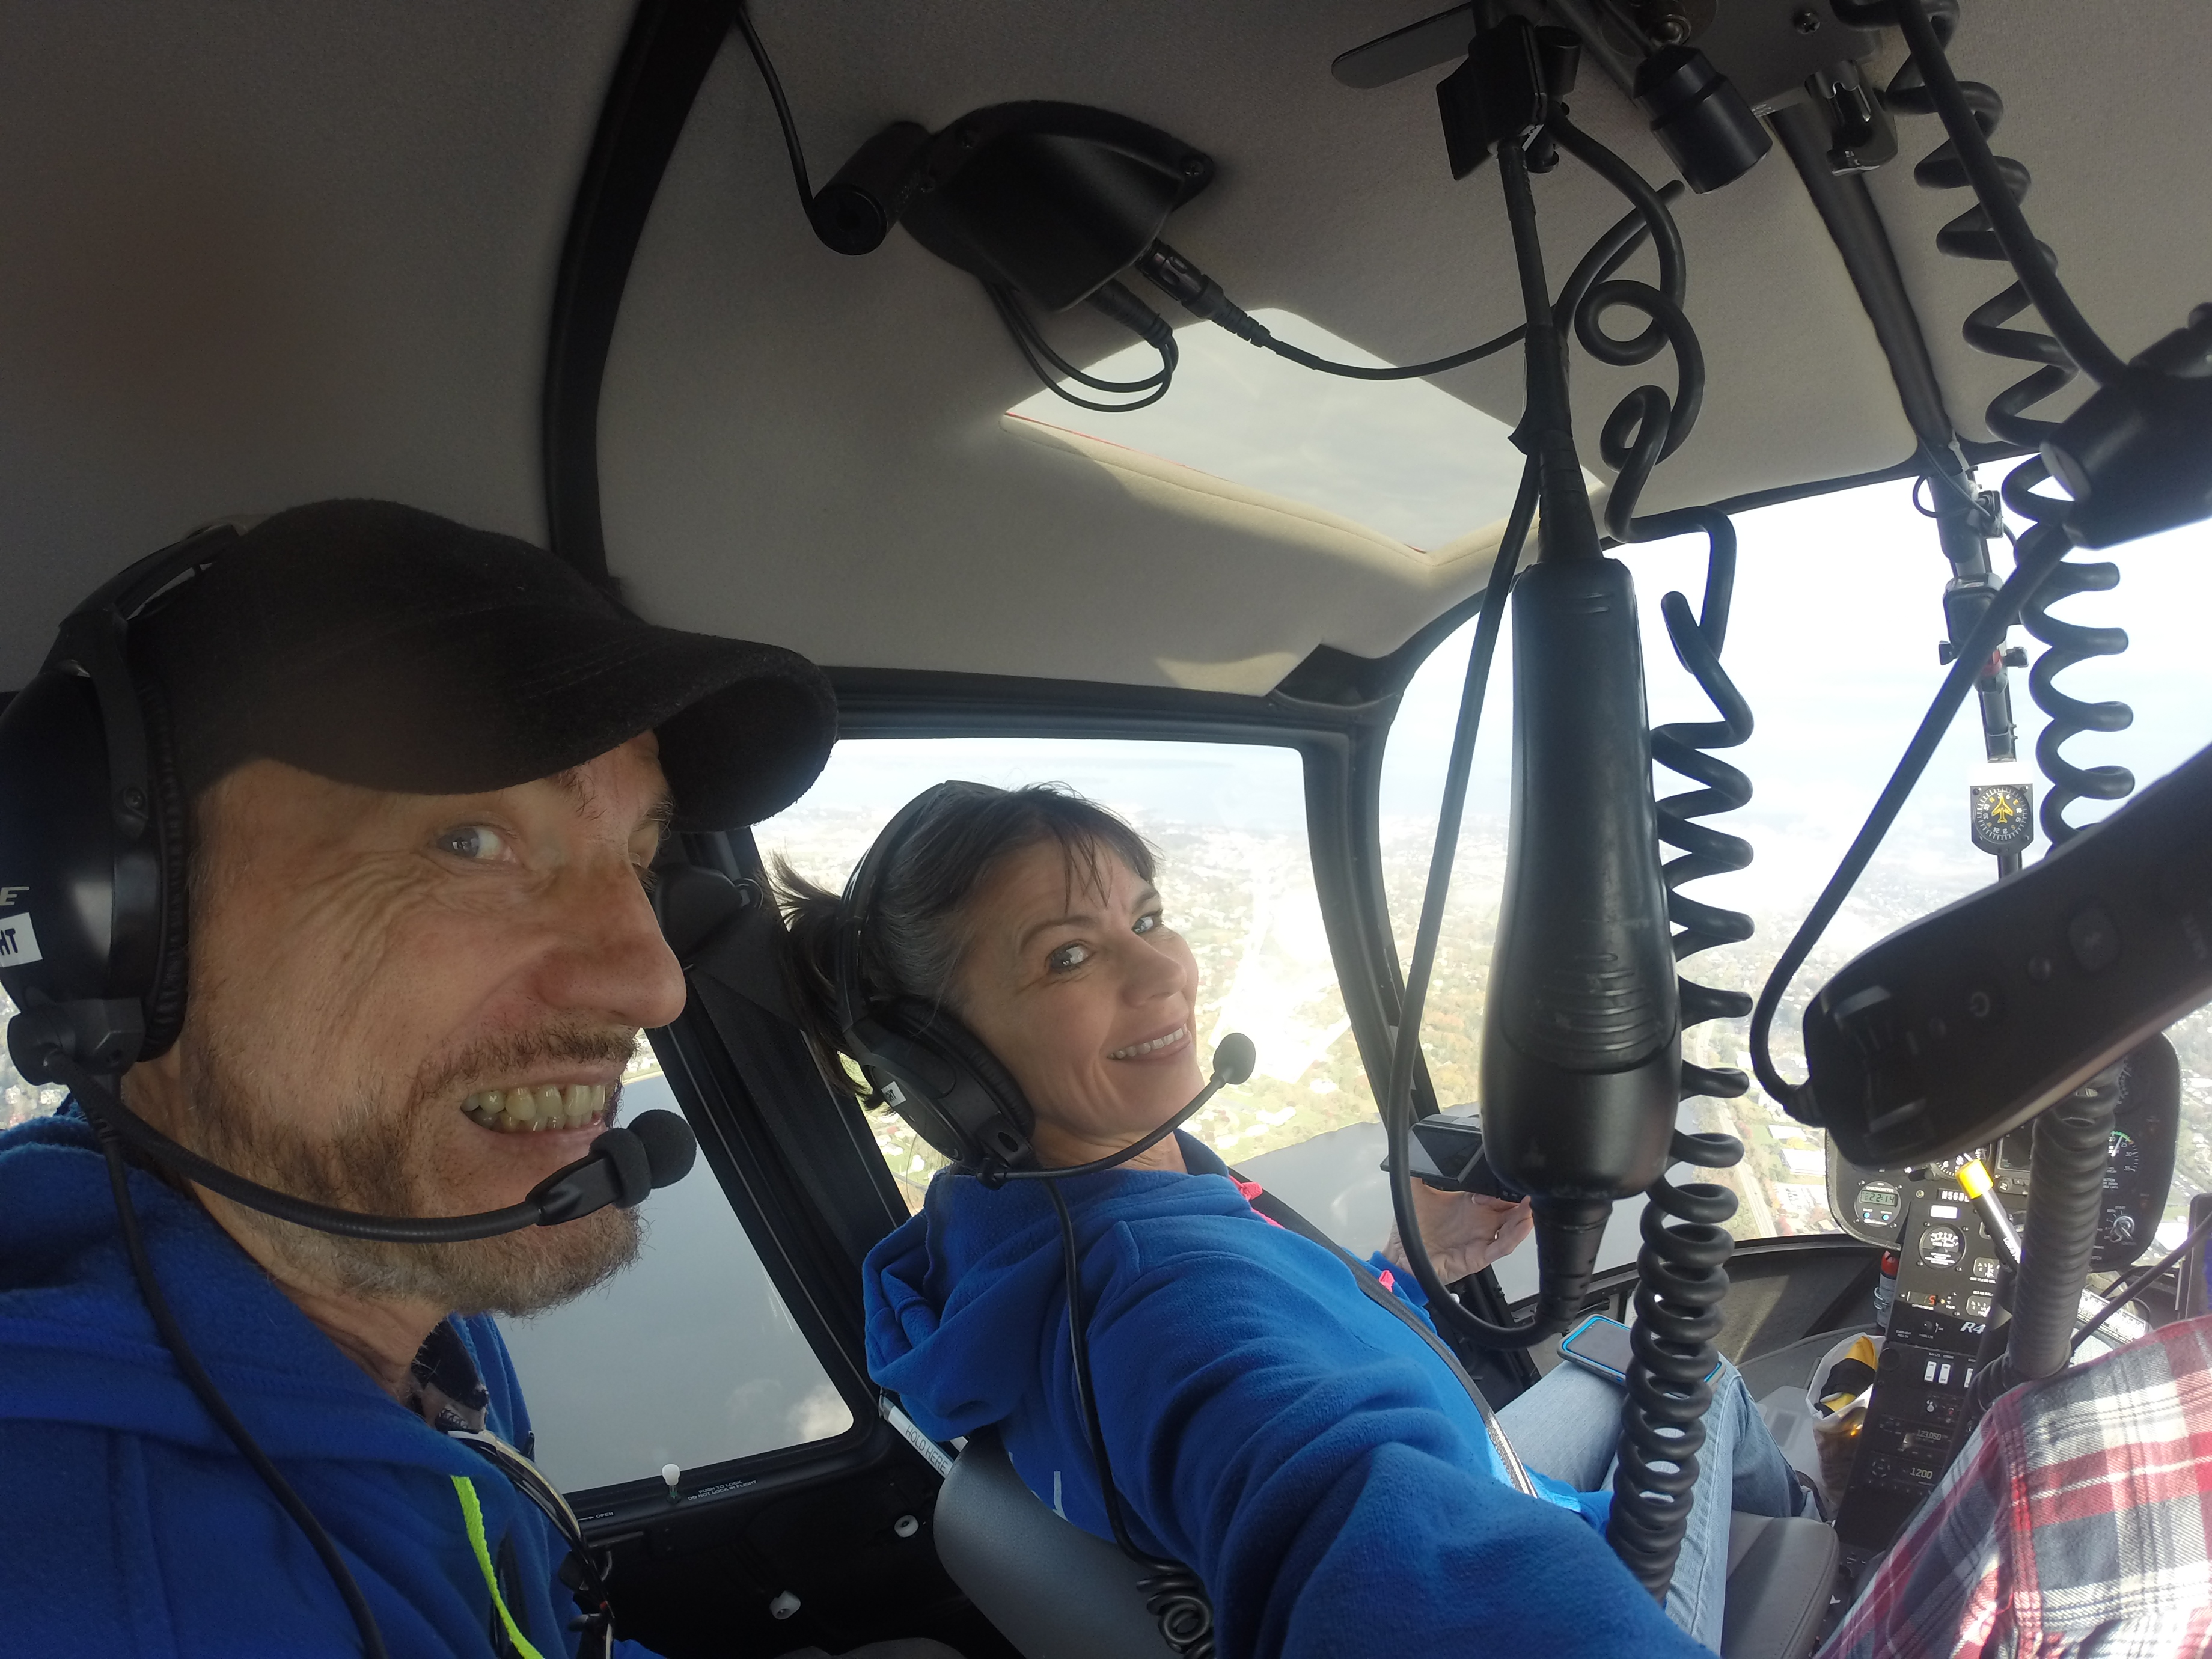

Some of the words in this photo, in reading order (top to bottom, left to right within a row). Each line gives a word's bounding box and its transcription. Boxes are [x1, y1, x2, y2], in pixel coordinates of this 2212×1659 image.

[1869, 1193, 1895, 1203] 22:14
[905, 1425, 926, 1452] HOLD
[926, 1445, 949, 1474] HERE
[1910, 1467, 1933, 1479] 1200
[736, 1480, 757, 1489] FLIGHT
